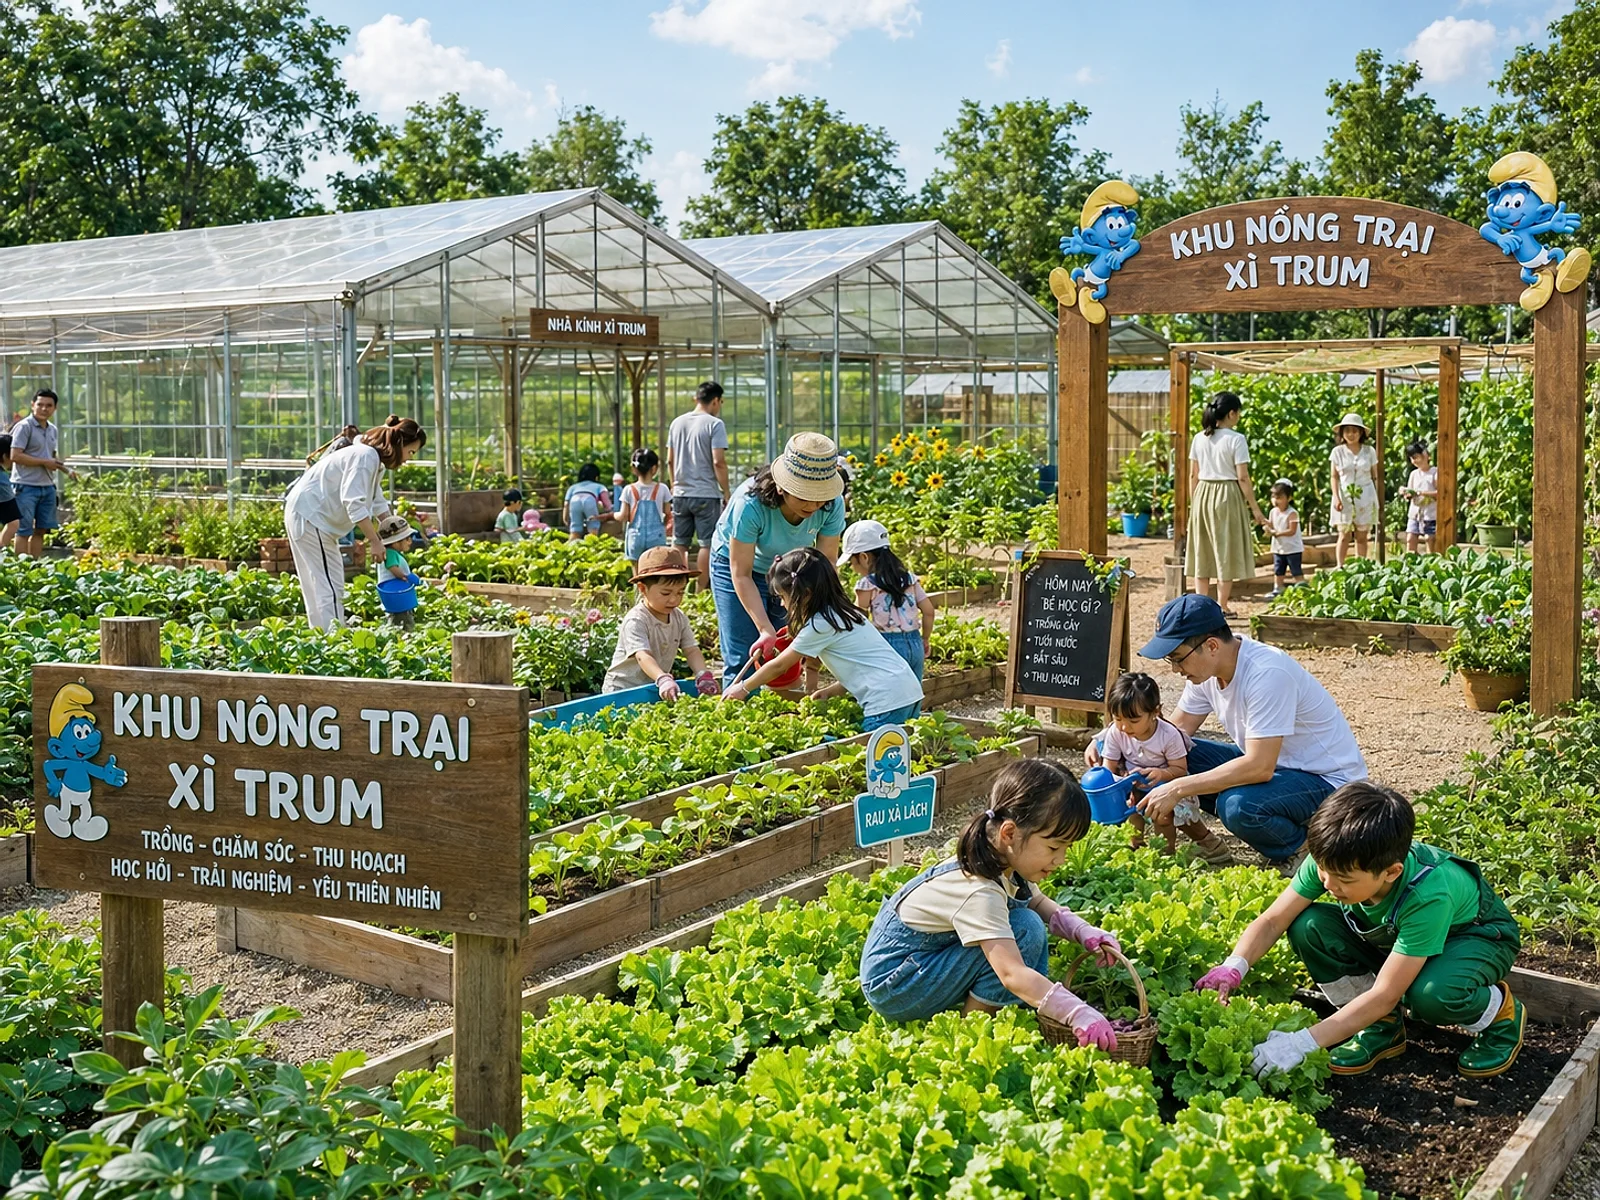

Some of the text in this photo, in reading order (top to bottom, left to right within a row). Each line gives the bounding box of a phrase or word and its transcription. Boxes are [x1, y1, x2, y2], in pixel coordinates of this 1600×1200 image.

[1170, 219, 1235, 260] KHU
[1353, 214, 1435, 257] TRẠI
[1224, 253, 1370, 291] XÌ TRUM
[548, 315, 646, 336] NHÀ KÍNH XÌ TRUM
[1044, 574, 1093, 592] HÔM NAY
[1042, 595, 1056, 611] BÉ
[1058, 599, 1078, 616] HỌC
[1031, 671, 1080, 687] THU HOẠCH
[113, 691, 470, 772] KHU NÔNG TRẠI
[168, 753, 384, 830] XÌ TRUM
[865, 800, 928, 828] RAU XÀ LÁCH
[212, 834, 259, 860] CHĂM
[264, 838, 295, 863] SÓC
[312, 846, 344, 868] THU
[350, 850, 406, 877] HOẠCH
[111, 857, 141, 881] HỌC
[146, 857, 171, 882] HỎI
[190, 861, 226, 888] TRẢI
[232, 868, 292, 897] NGHIỆM
[312, 874, 341, 900] YÊU
[346, 879, 390, 905] THIÊN
[395, 884, 441, 911] NHIÊN
